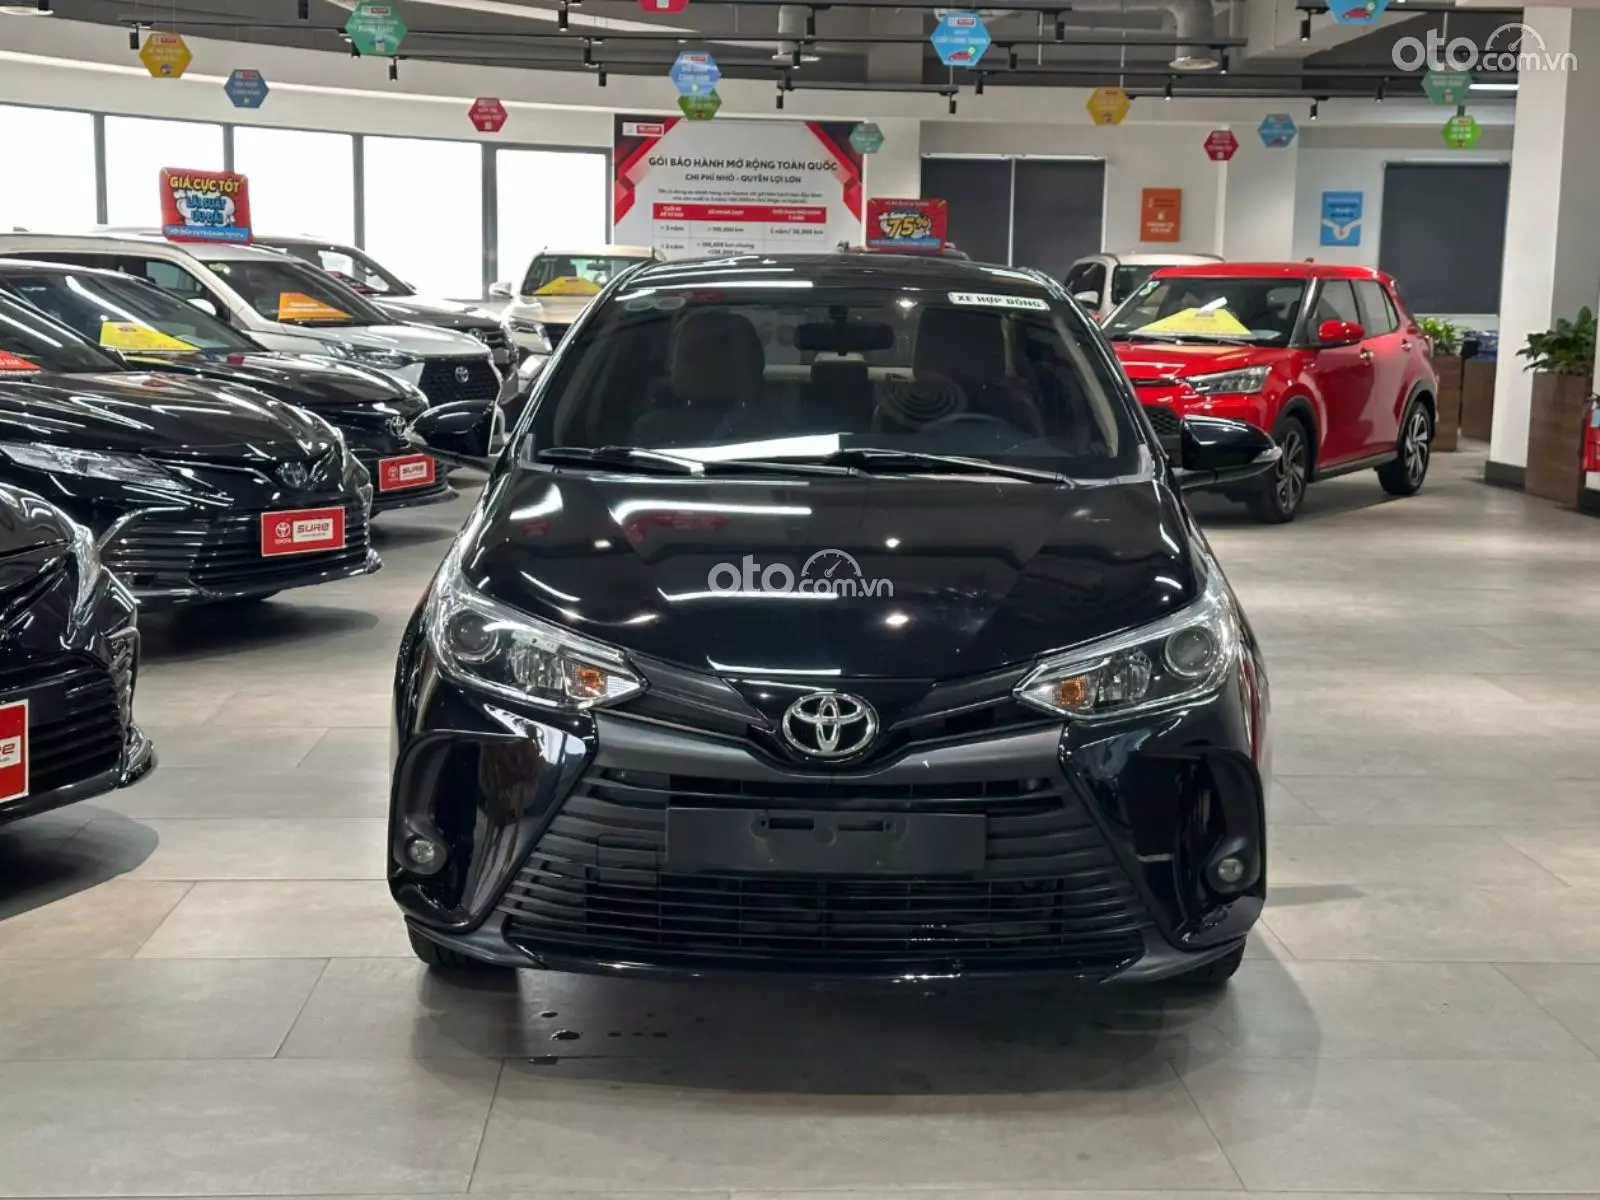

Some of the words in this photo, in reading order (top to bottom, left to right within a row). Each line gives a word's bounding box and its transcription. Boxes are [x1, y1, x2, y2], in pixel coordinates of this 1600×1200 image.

[649, 155, 668, 167] GÓI
[670, 156, 692, 168] BẢO
[694, 157, 725, 169] HÀNH
[726, 157, 744, 169] MỞ
[746, 157, 776, 171] RỘNG
[777, 159, 806, 171] TOÀN
[807, 159, 838, 171] QUỐC
[170, 175, 191, 189] GIÁ
[193, 178, 217, 192] CỰC
[219, 178, 240, 193] TỐT
[685, 173, 699, 181] CHI
[701, 173, 715, 181] PHÍ
[716, 173, 735, 182] NHỎ
[741, 173, 769, 183] QUYỀN
